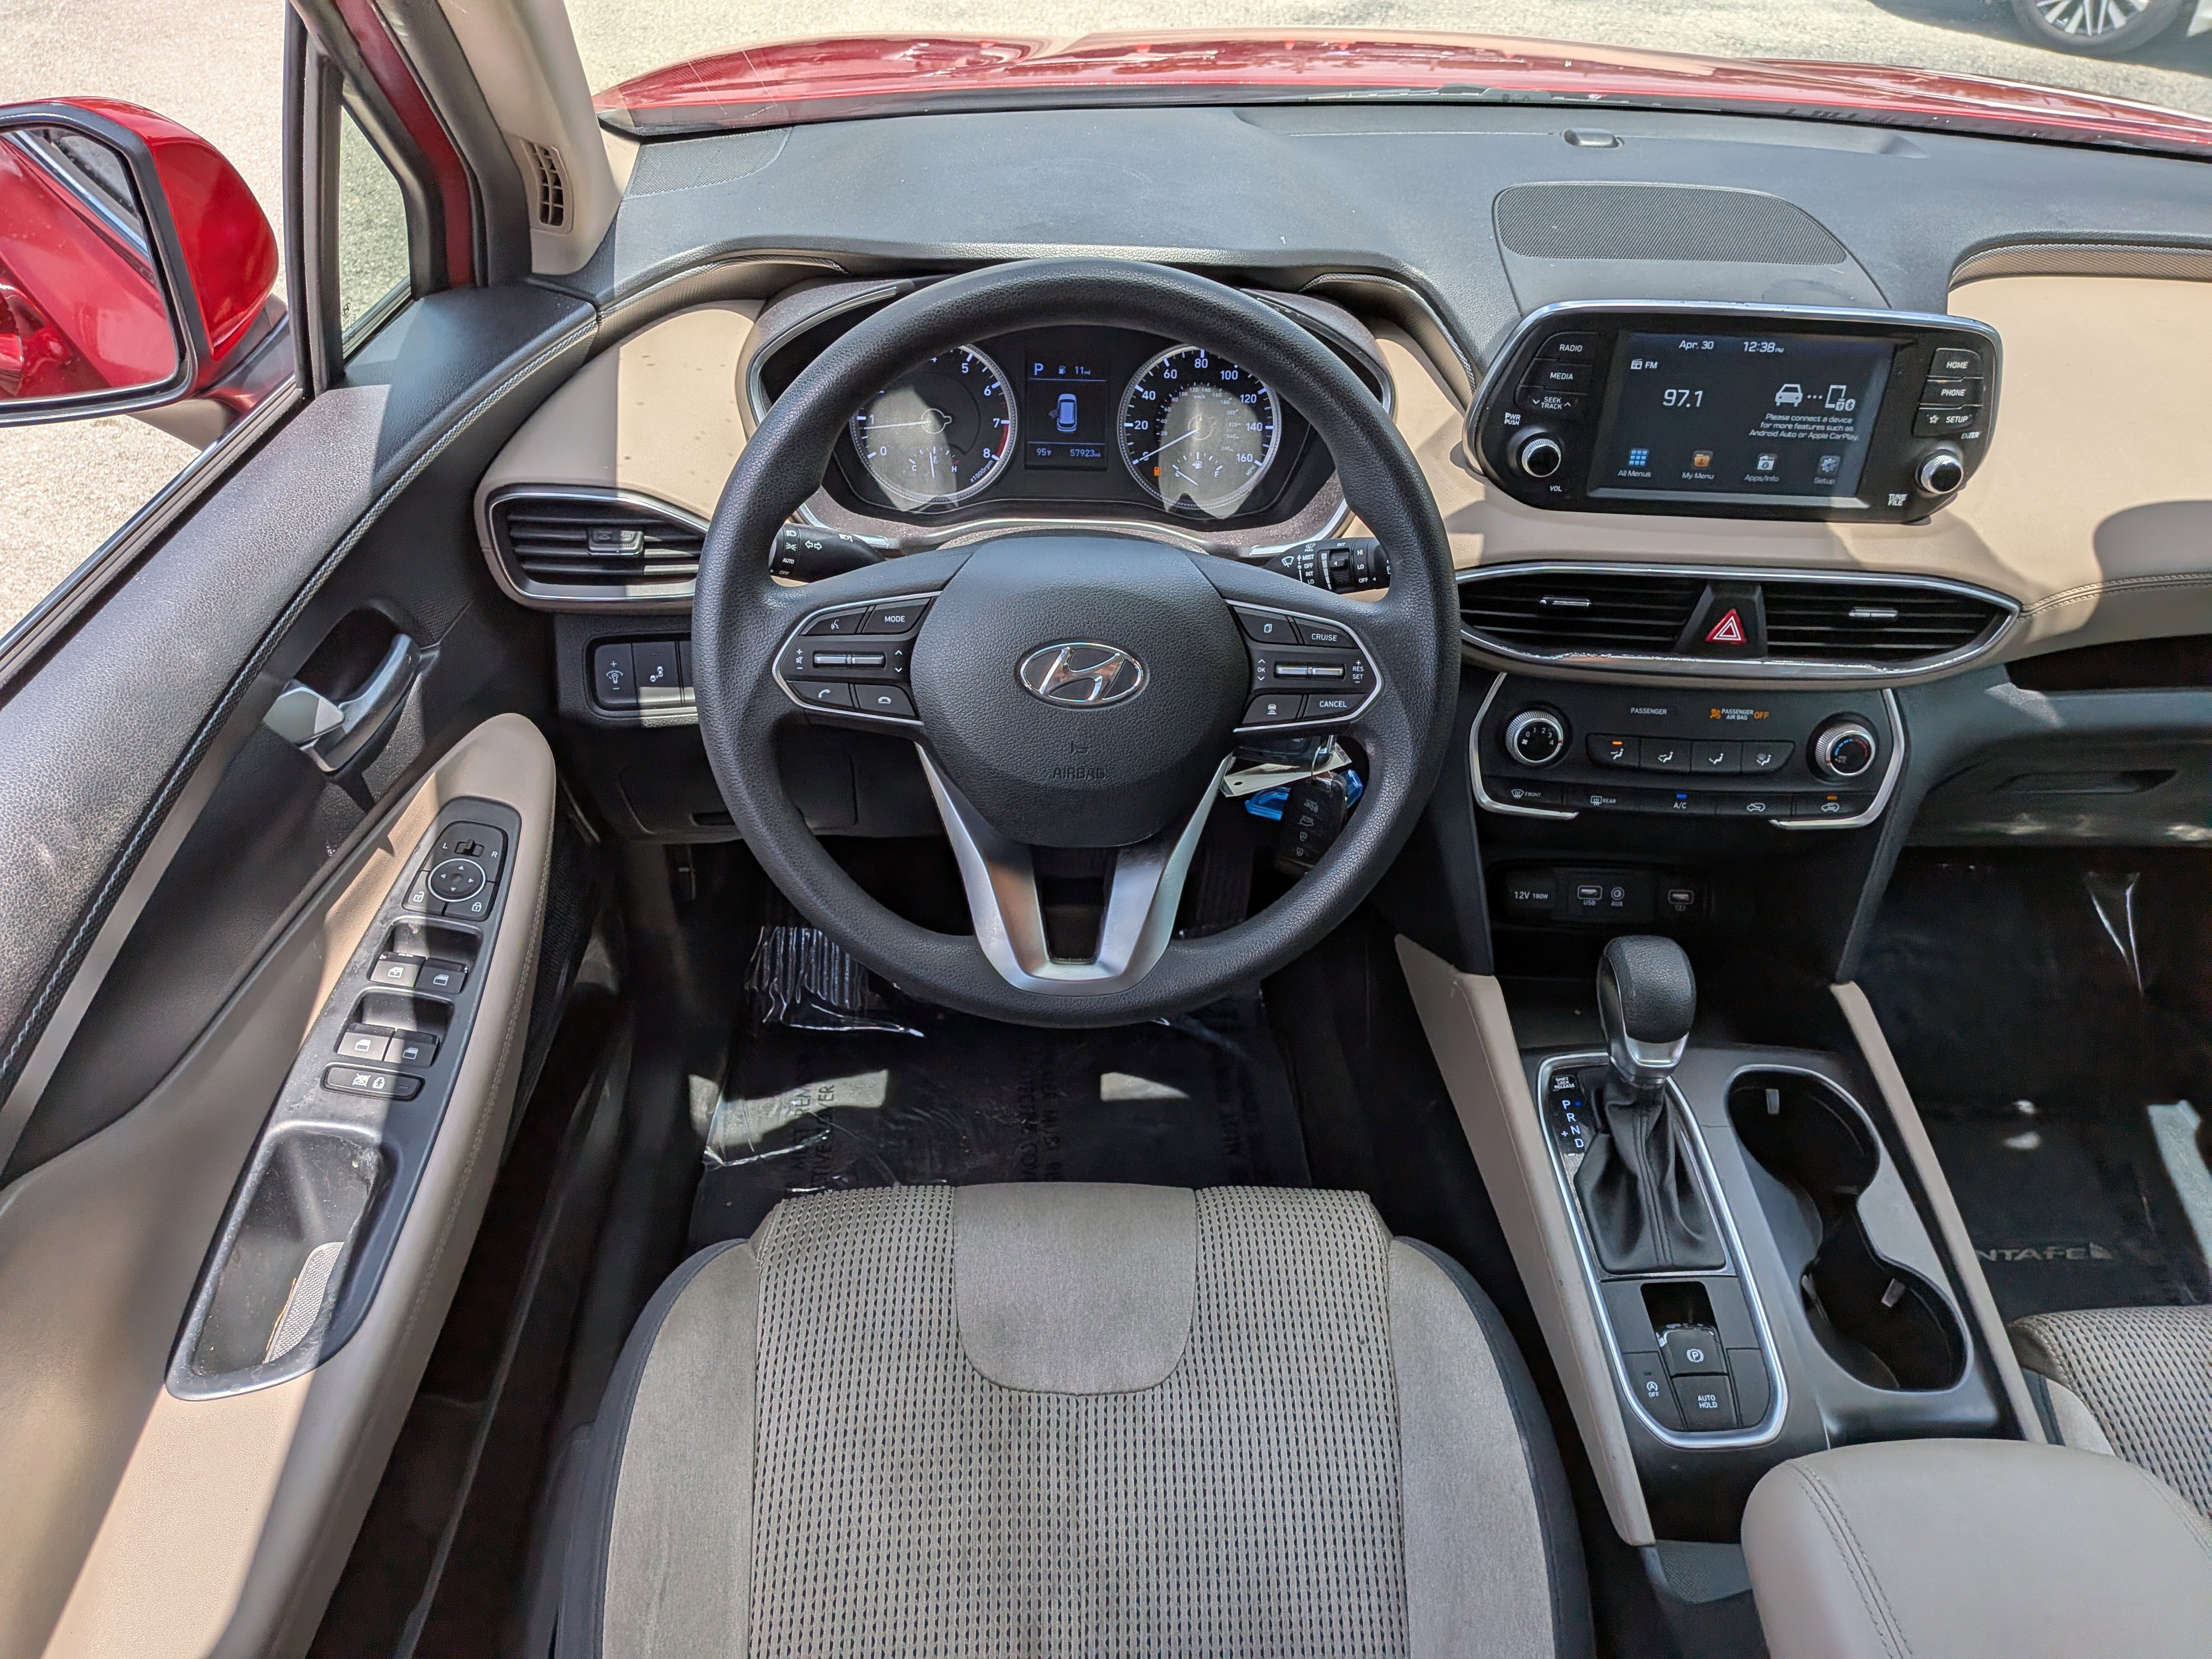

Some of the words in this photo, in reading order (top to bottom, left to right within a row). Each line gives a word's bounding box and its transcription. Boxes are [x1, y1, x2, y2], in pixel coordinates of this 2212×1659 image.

[1559, 344, 1583, 352] RADIO
[1678, 340, 1699, 351] Apr.
[1701, 341, 1714, 349] 30
[1194, 358, 1208, 368] 80
[962, 363, 968, 373] 5
[1034, 363, 1044, 375] P
[1164, 369, 1177, 379] 60
[1220, 371, 1238, 380] 100
[1550, 372, 1573, 380] MEDIA
[984, 386, 991, 396] 6
[1142, 391, 1156, 400] 40
[1240, 394, 1256, 404] 120
[1663, 389, 1703, 408] 97.1
[870, 415, 874, 424] 1
[1505, 412, 1521, 421] PWR
[1765, 413, 1790, 421] Please
[993, 418, 1000, 427] 7
[1134, 420, 1148, 429] 20
[1246, 422, 1262, 431] 140
[1808, 431, 1828, 440] Apple
[880, 446, 886, 456] 0
[983, 448, 990, 458] 8
[1237, 453, 1253, 462] 160
[970, 460, 993, 483] x1000rpm
[1813, 477, 1835, 485] Setup
[1311, 633, 1337, 641] CRUISE
[1053, 767, 1106, 779] AIRBAG
[1562, 1100, 1571, 1109] P
[1566, 1113, 1576, 1122] R
[1570, 1125, 1580, 1135] N
[1574, 1138, 1584, 1148] D
[1974, 1248, 2043, 1261] NTA
